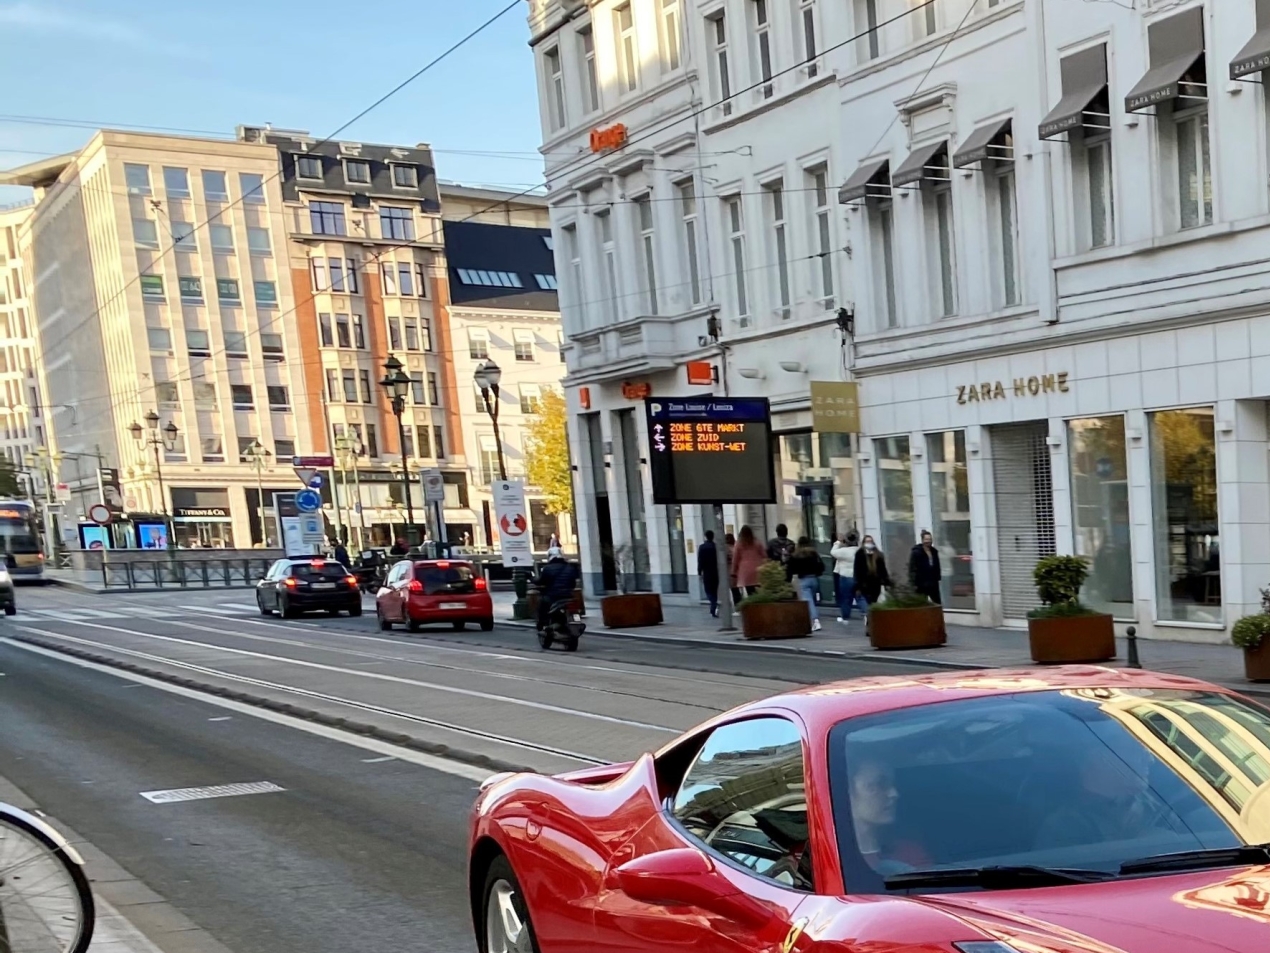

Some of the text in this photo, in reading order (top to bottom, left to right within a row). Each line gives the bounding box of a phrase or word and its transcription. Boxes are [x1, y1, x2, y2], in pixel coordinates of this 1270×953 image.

[1234, 61, 1256, 74] ZARA
[1130, 87, 1171, 108] ZARA HOME
[1041, 116, 1077, 135] ZARA HOME
[956, 371, 1070, 405] ZARA HOME
[815, 396, 854, 405] ZARA
[815, 409, 856, 418] HOME
[670, 423, 693, 432] ZONE
[717, 423, 745, 432] MARKT
[670, 433, 719, 442] ZONE ZUID
[671, 442, 694, 451] ZONE
